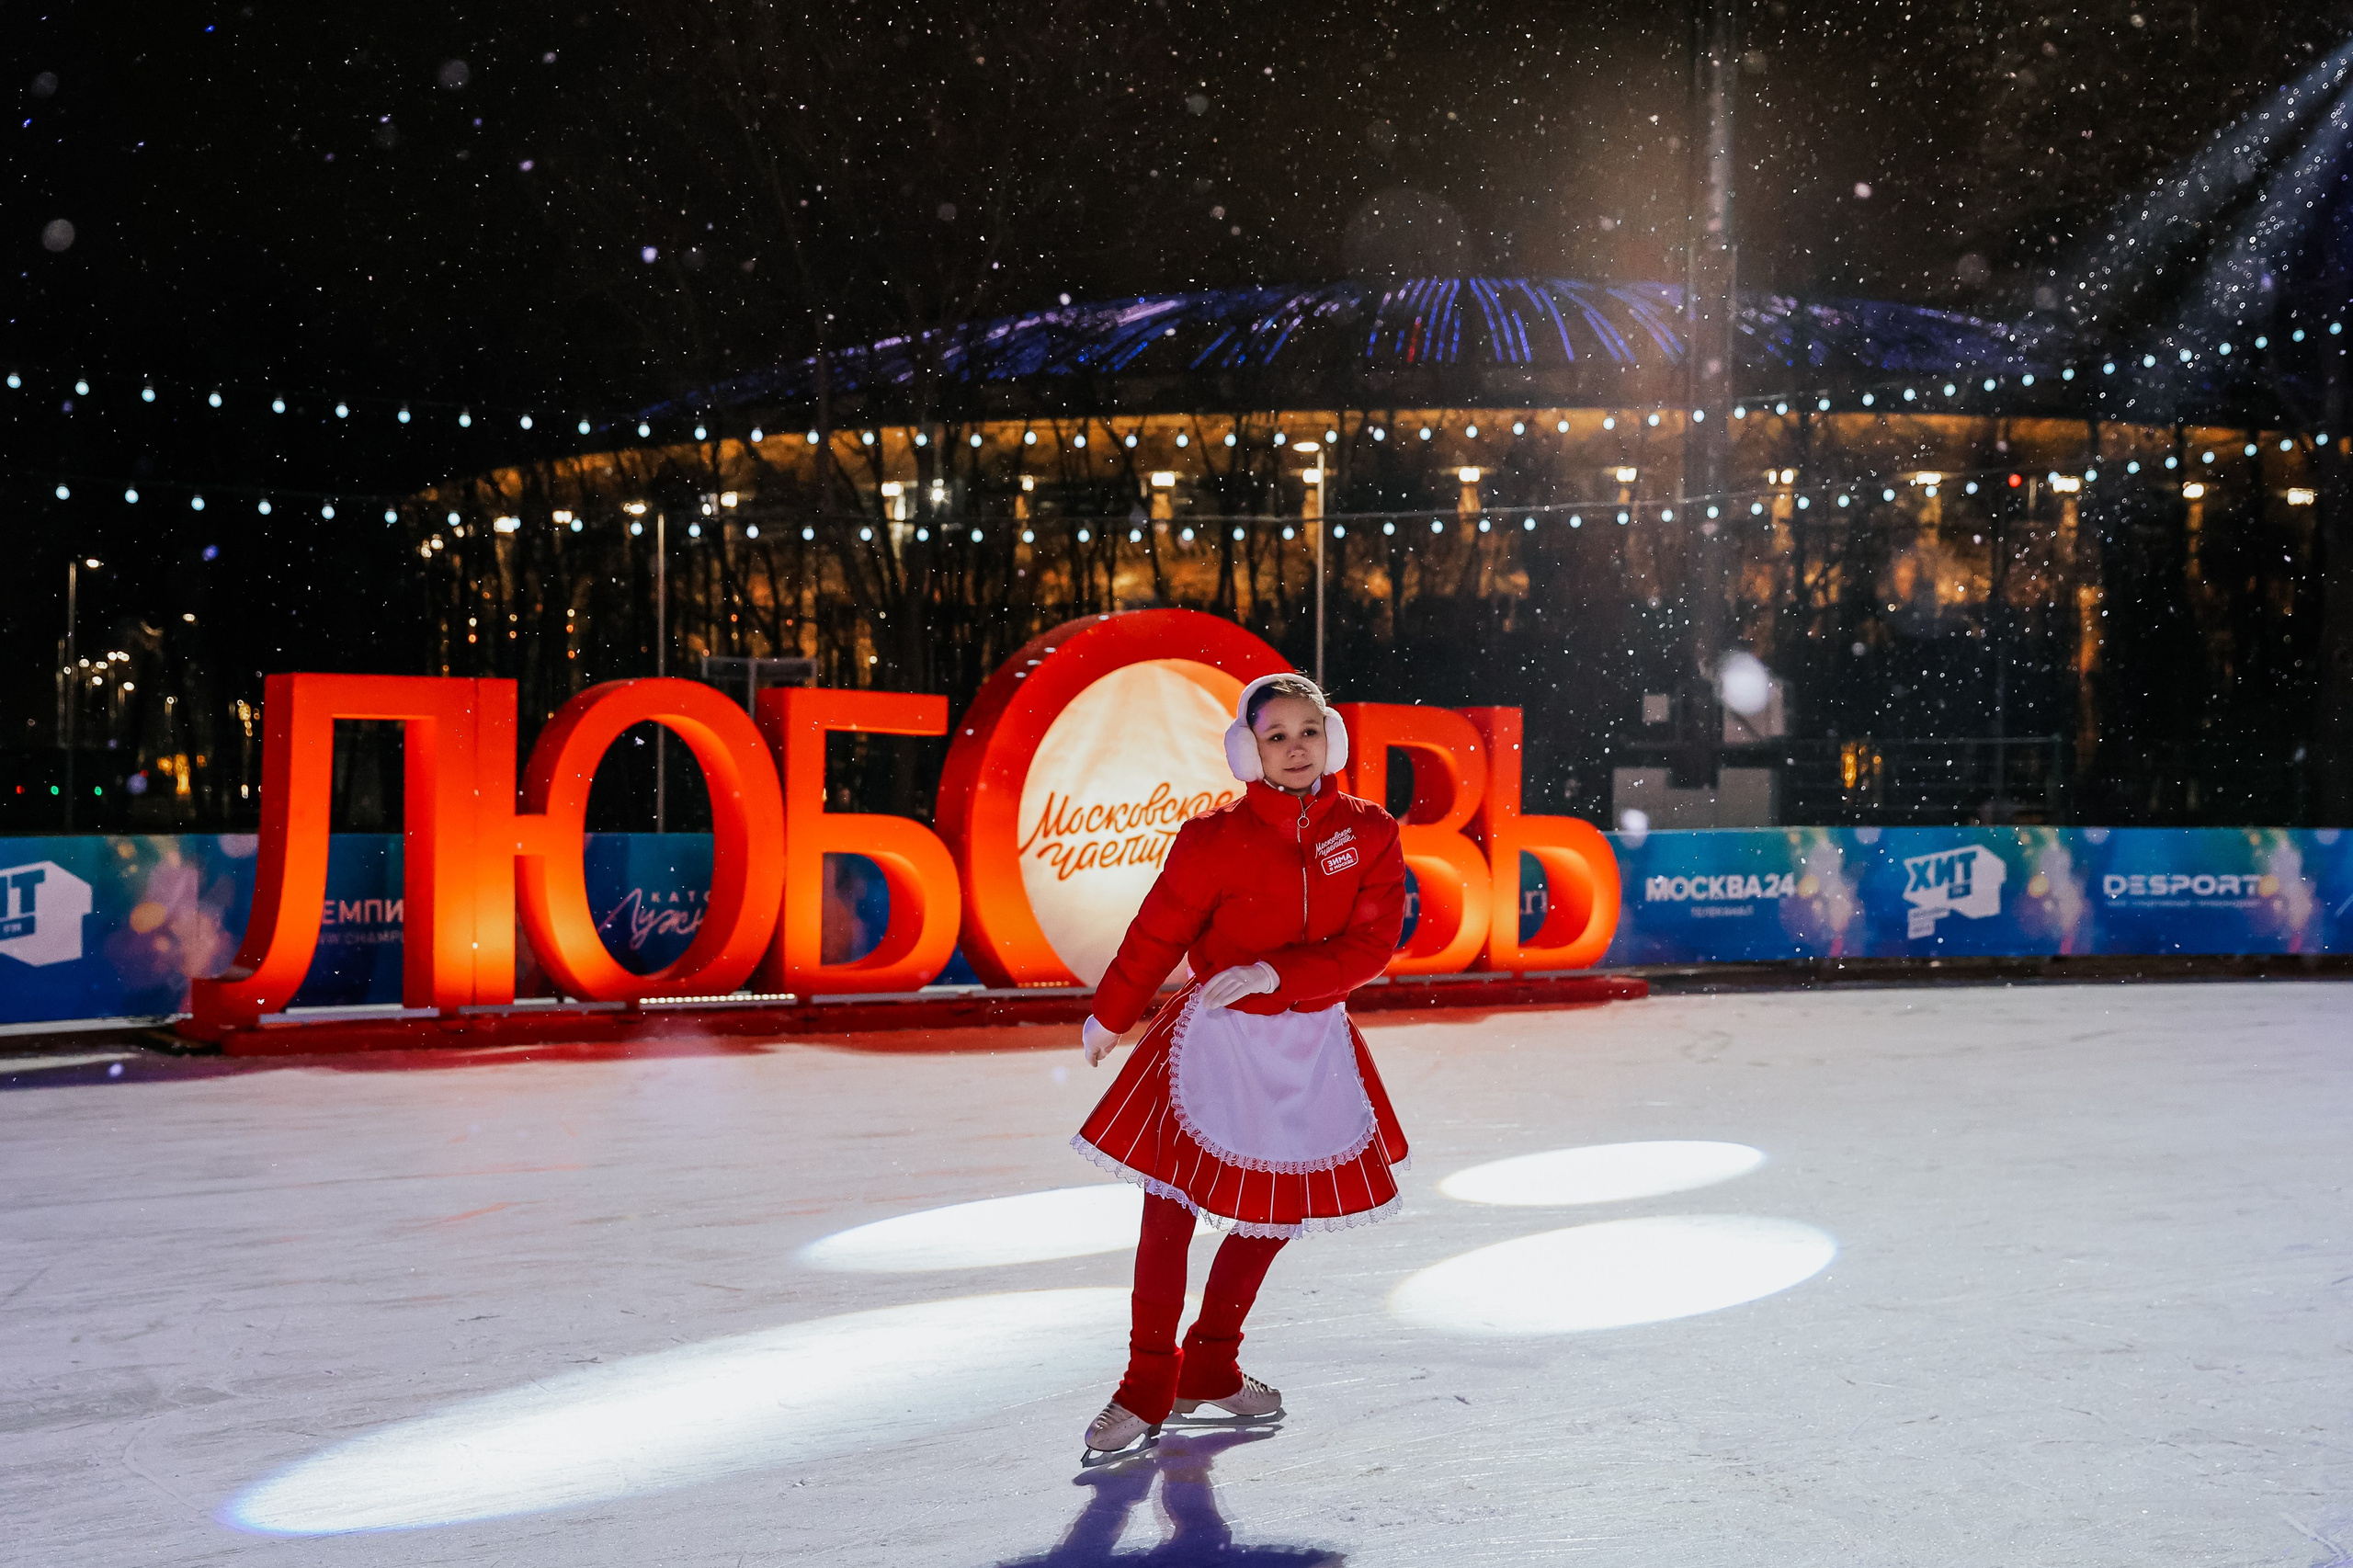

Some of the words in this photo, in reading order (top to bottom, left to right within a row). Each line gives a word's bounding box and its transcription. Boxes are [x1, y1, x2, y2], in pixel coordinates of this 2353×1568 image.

[191, 608, 1621, 1020] ЛЮБОВЬ
[1036, 829, 1178, 881] чаепит
[1314, 827, 1352, 859] Московское
[1326, 852, 1352, 868] ЗИМА
[1910, 851, 1978, 892] ХИТ
[651, 890, 711, 903] КАТ
[2103, 874, 2262, 896] DESPORT
[323, 899, 404, 925] ЕМПИ
